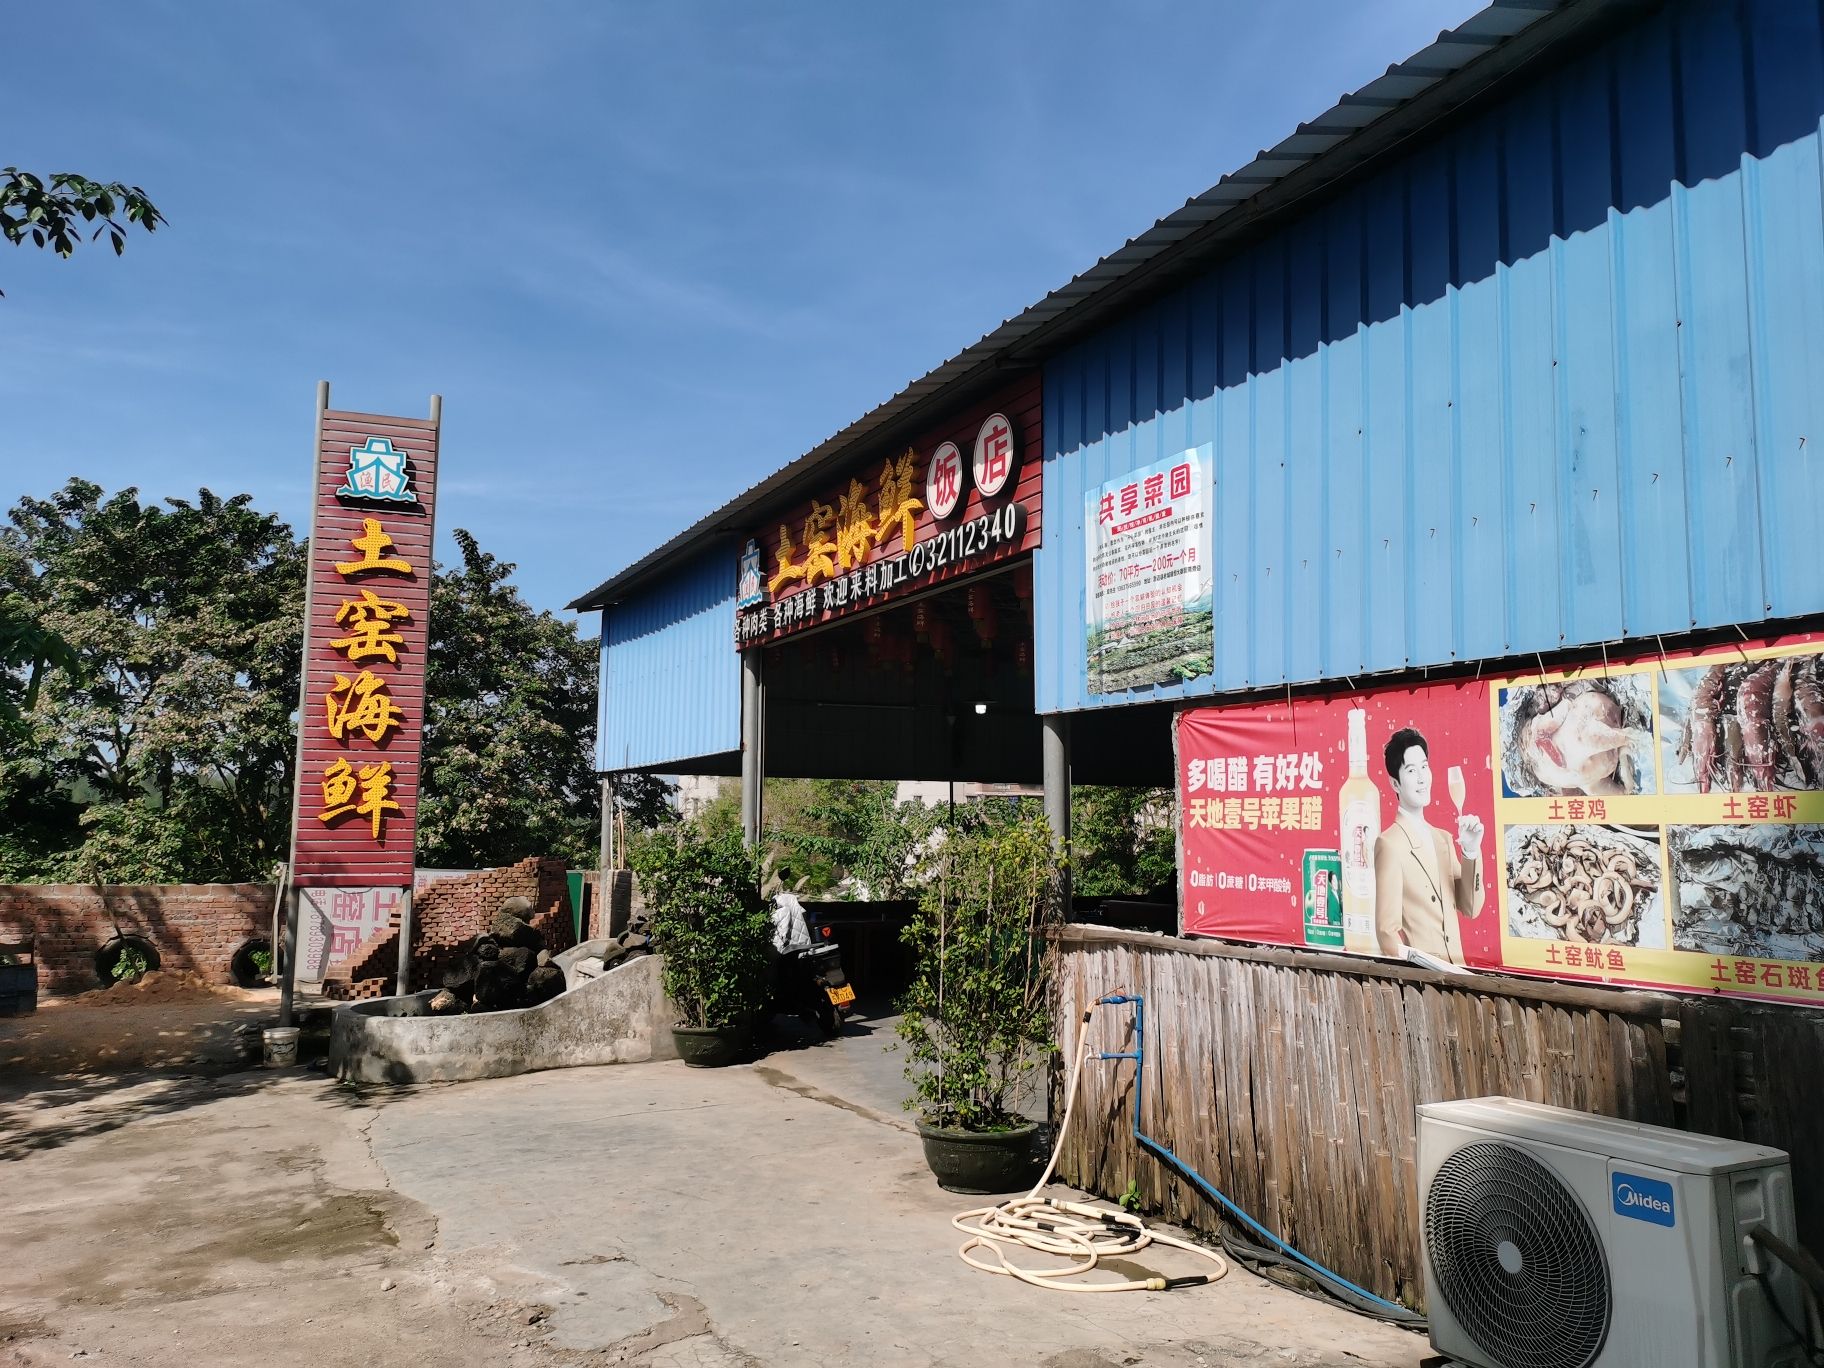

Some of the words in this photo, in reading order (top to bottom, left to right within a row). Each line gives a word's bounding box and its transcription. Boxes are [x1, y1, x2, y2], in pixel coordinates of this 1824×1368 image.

[768, 446, 924, 593] 土窑海鲜
[933, 424, 1009, 507] 饭店
[1098, 462, 1192, 526] 共享菜园
[734, 606, 768, 641] 各种肉类
[774, 588, 817, 629] 各种海鲜
[926, 503, 1016, 571] 32112340
[318, 517, 412, 839] 土窑海鲜
[1187, 757, 1248, 793] 多喝醋
[1253, 751, 1323, 793] 有好处
[1188, 796, 1323, 831] 天地壹号苹果醋
[1548, 799, 1606, 821] 土窑鸡
[1723, 796, 1798, 820] 土窑虾
[1546, 944, 1626, 972] 土窑鱿鱼
[1618, 1184, 1671, 1213] Midea
